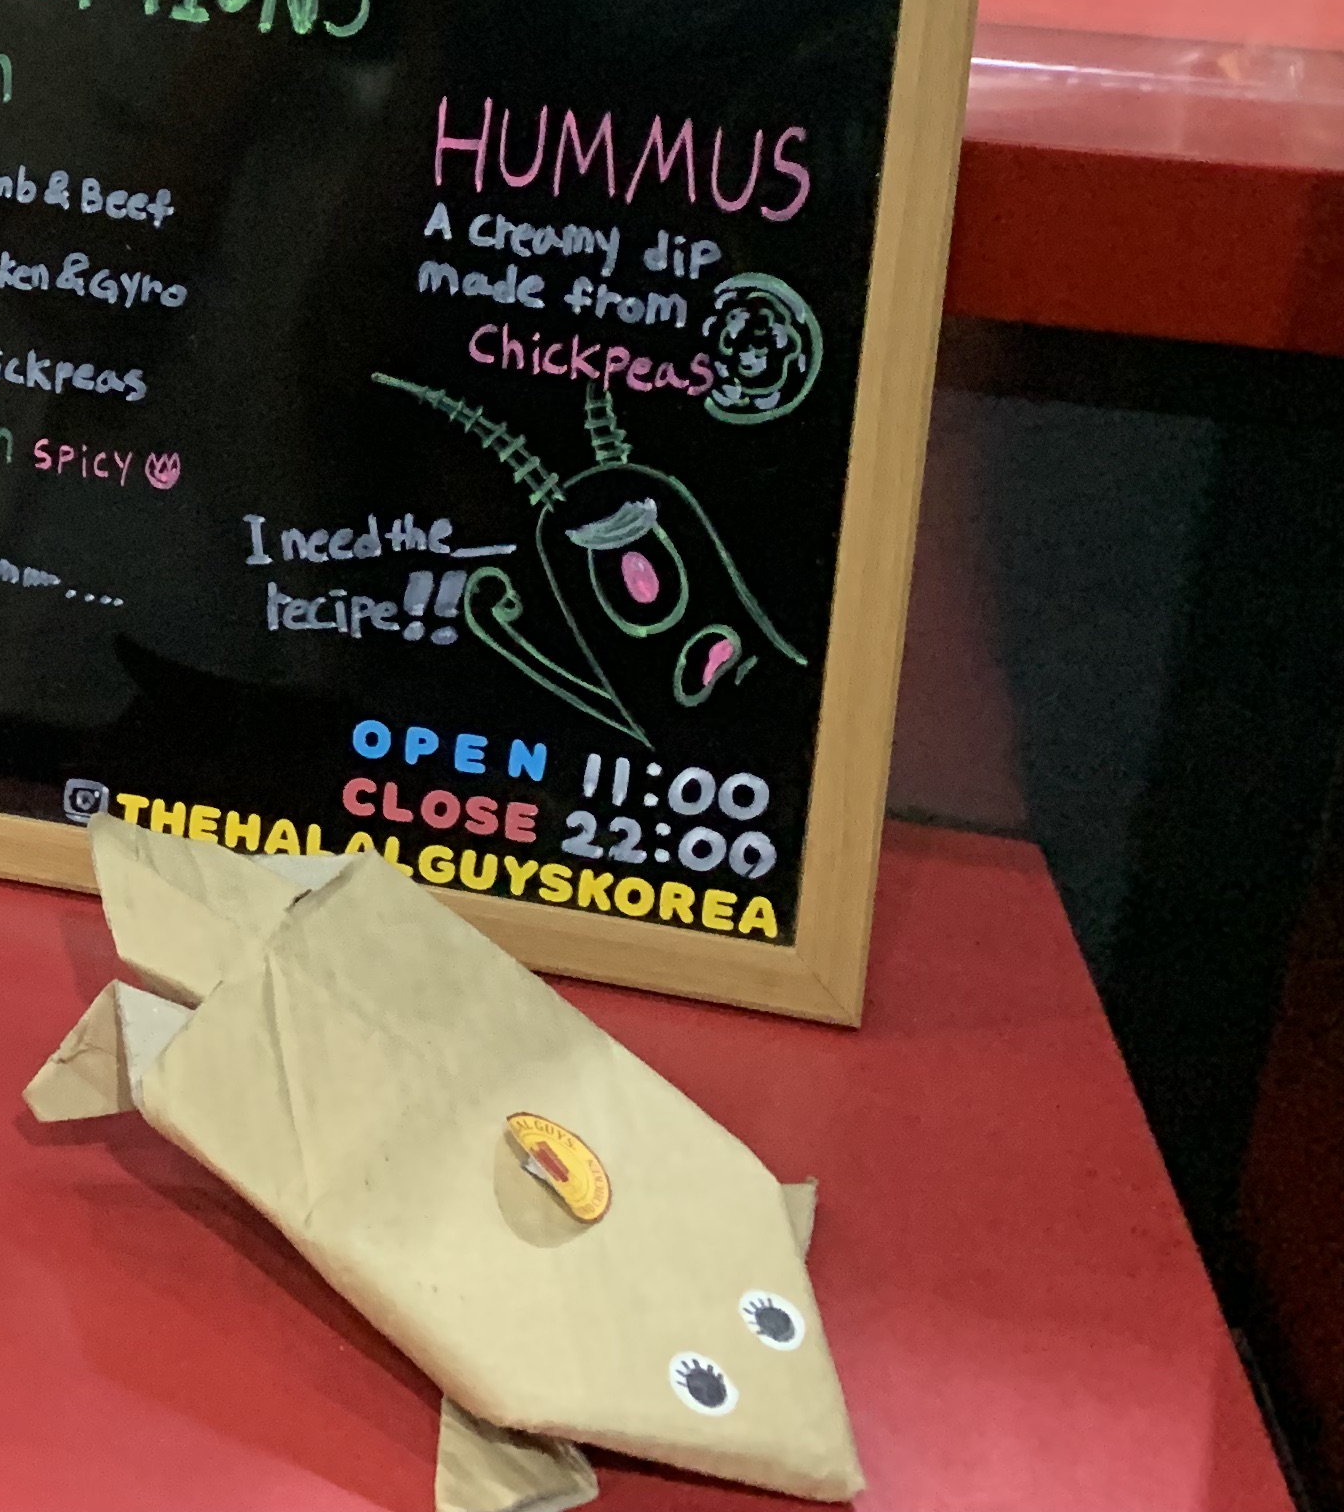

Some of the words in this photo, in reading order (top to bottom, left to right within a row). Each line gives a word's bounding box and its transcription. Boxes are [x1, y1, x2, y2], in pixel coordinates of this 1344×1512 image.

[433, 94, 811, 223] HUMMUS
[43, 170, 70, 211] &
[80, 177, 174, 228] Beef
[423, 201, 453, 241] A
[644, 229, 722, 280] dip
[563, 275, 688, 328] from
[468, 322, 713, 396] Chickpeas
[242, 513, 274, 565] I
[352, 719, 548, 782] OPEN
[582, 753, 770, 821] 11:00
[341, 777, 539, 844] CLOSE
[534, 1120, 574, 1149] GUYS
